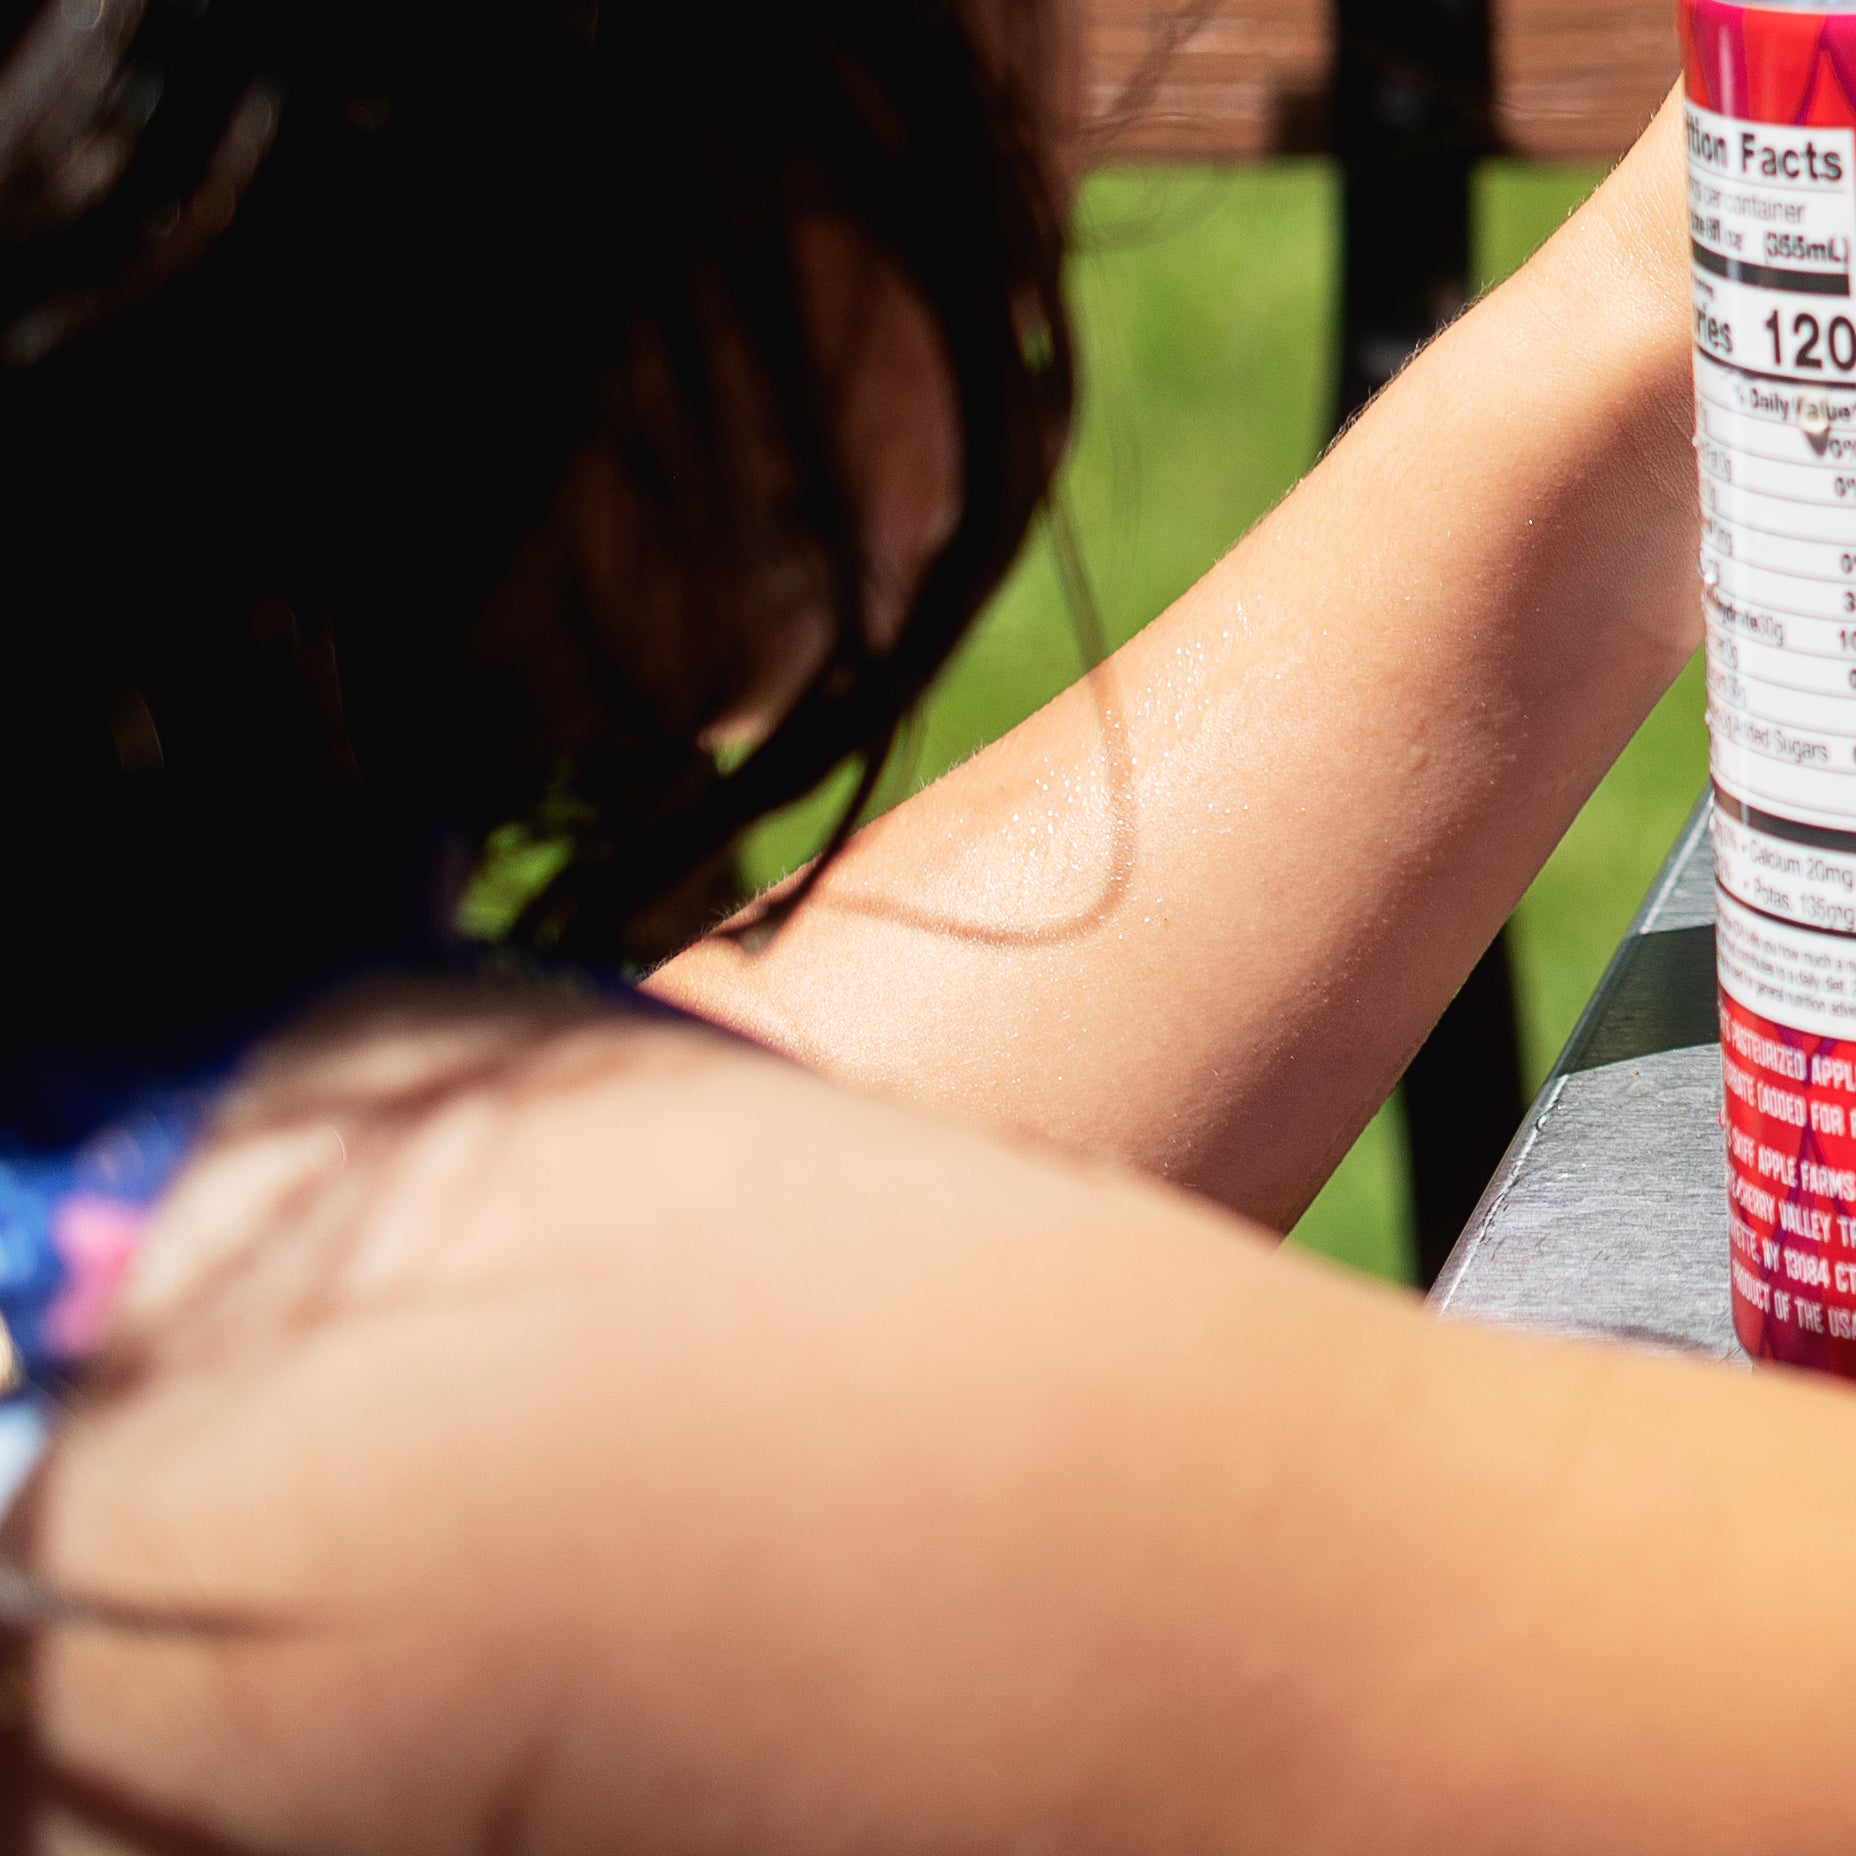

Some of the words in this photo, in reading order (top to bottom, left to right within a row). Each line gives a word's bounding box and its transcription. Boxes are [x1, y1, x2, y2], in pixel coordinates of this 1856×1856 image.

[1741, 132, 1843, 182] Facts
[1751, 388, 1789, 421] Daily
[1776, 730, 1829, 764] Sugars
[1751, 840, 1801, 874] Calcium
[1810, 1101, 1846, 1138] FOR
[1758, 1145, 1798, 1189] APPLE
[1779, 1199, 1832, 1243] VALLEY
[1762, 1237, 1781, 1272] NY
[1783, 1248, 1831, 1288] 13084
[1773, 1290, 1792, 1322] OF
[1794, 1295, 1824, 1333] THE
